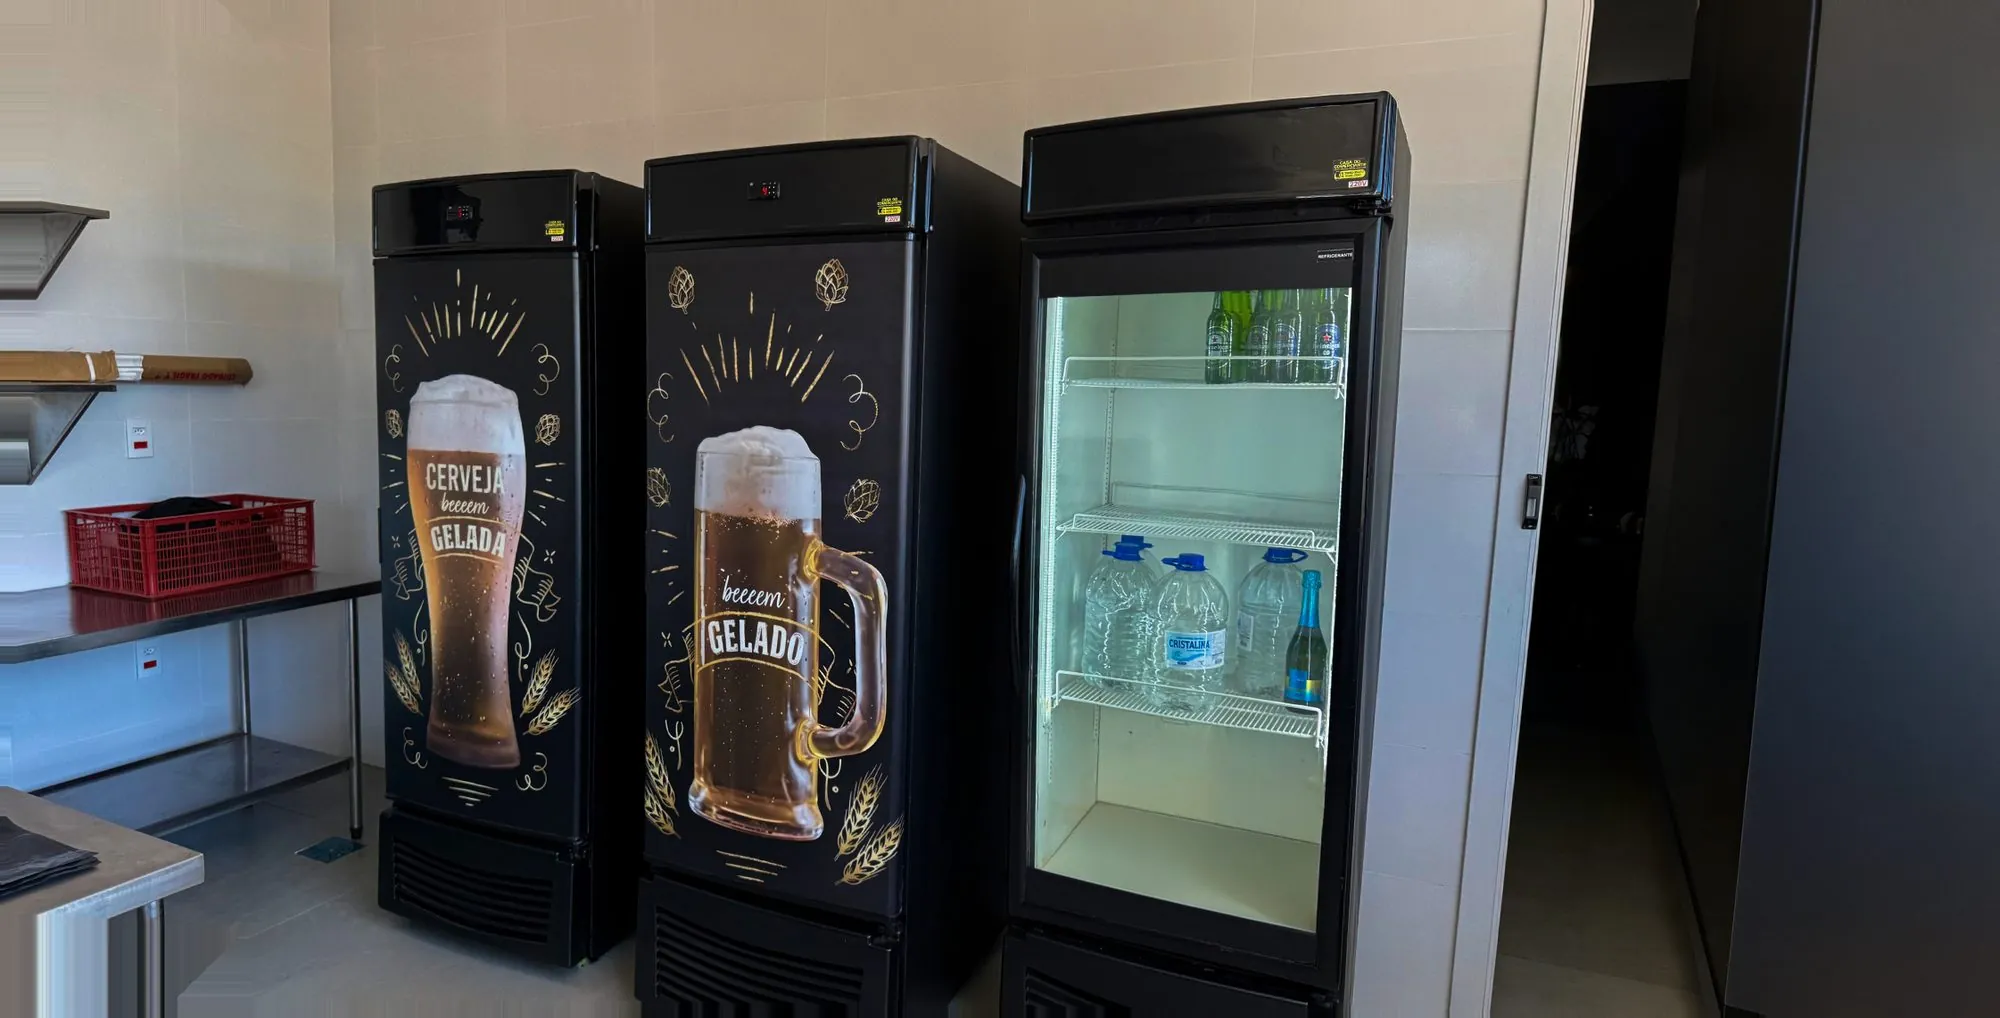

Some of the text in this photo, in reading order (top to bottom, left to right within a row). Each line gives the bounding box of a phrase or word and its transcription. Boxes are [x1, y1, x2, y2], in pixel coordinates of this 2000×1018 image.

[426, 463, 505, 494] CERVEJA
[441, 492, 490, 514] beeeem
[430, 524, 507, 558] GELADA
[722, 575, 785, 608] beeeem
[708, 619, 805, 666] GELADO
[1169, 639, 1210, 649] CRISTALINA
